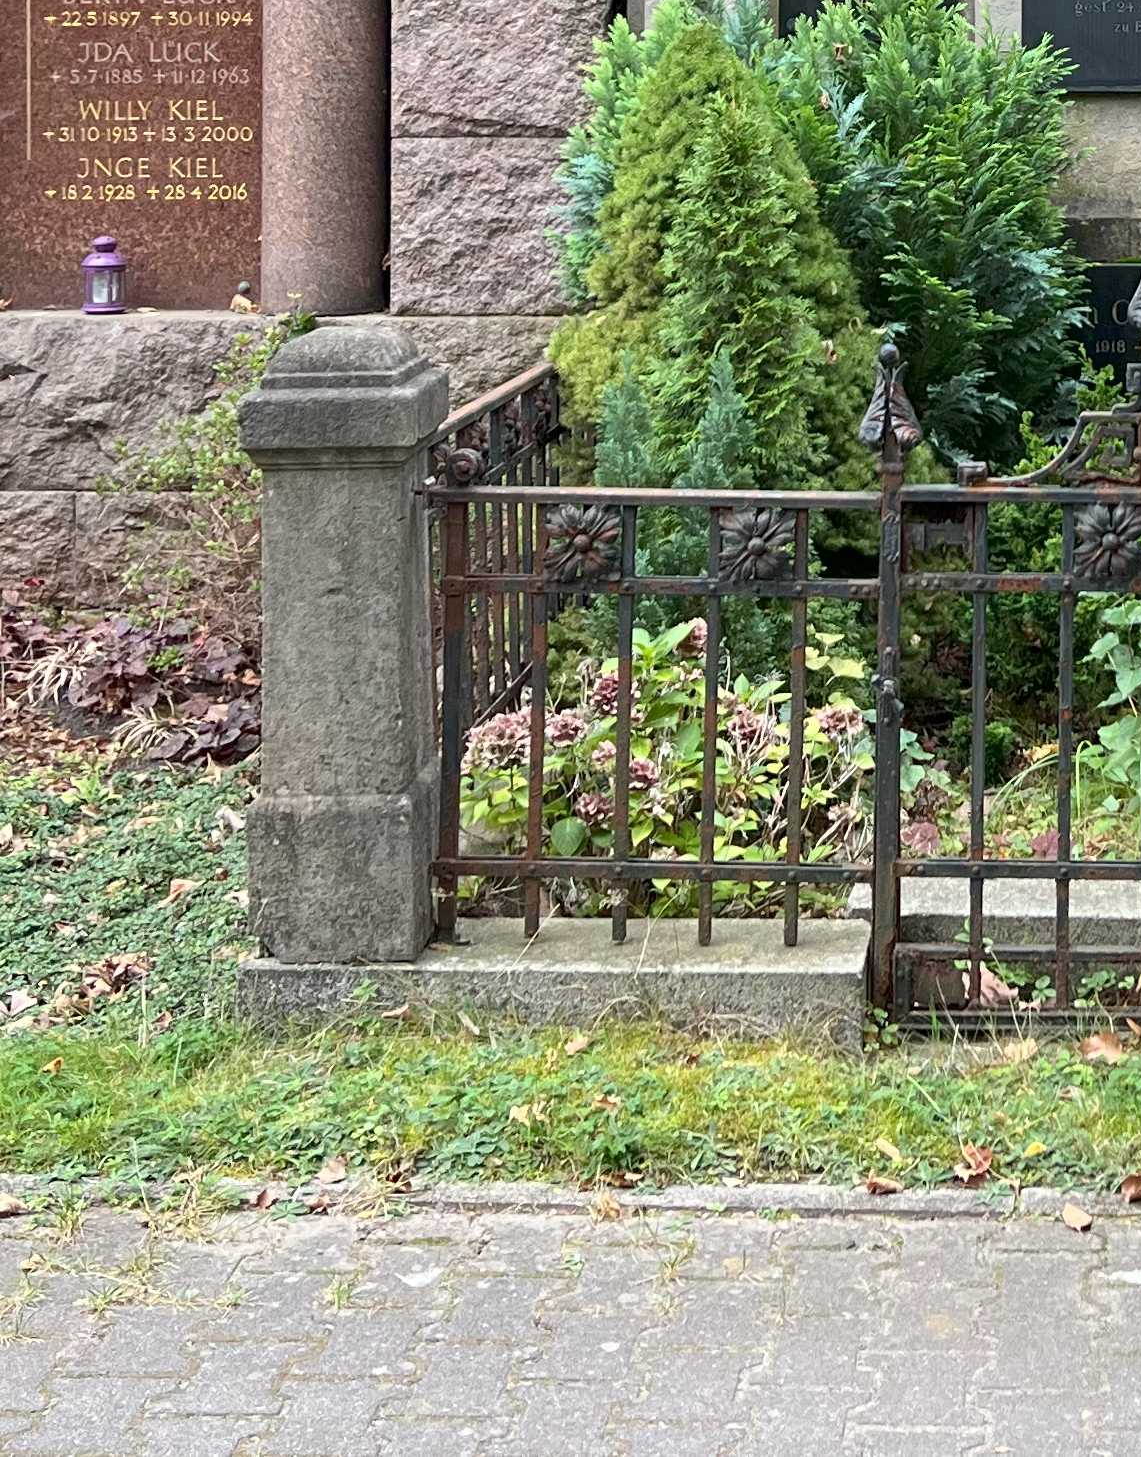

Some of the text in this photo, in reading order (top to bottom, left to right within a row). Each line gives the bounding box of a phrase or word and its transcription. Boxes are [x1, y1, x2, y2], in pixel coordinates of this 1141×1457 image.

[78, 40, 221, 63] JDA LÜCK
[79, 99, 225, 121] WILLY KIEL
[77, 157, 224, 178] JNGE KIEL
